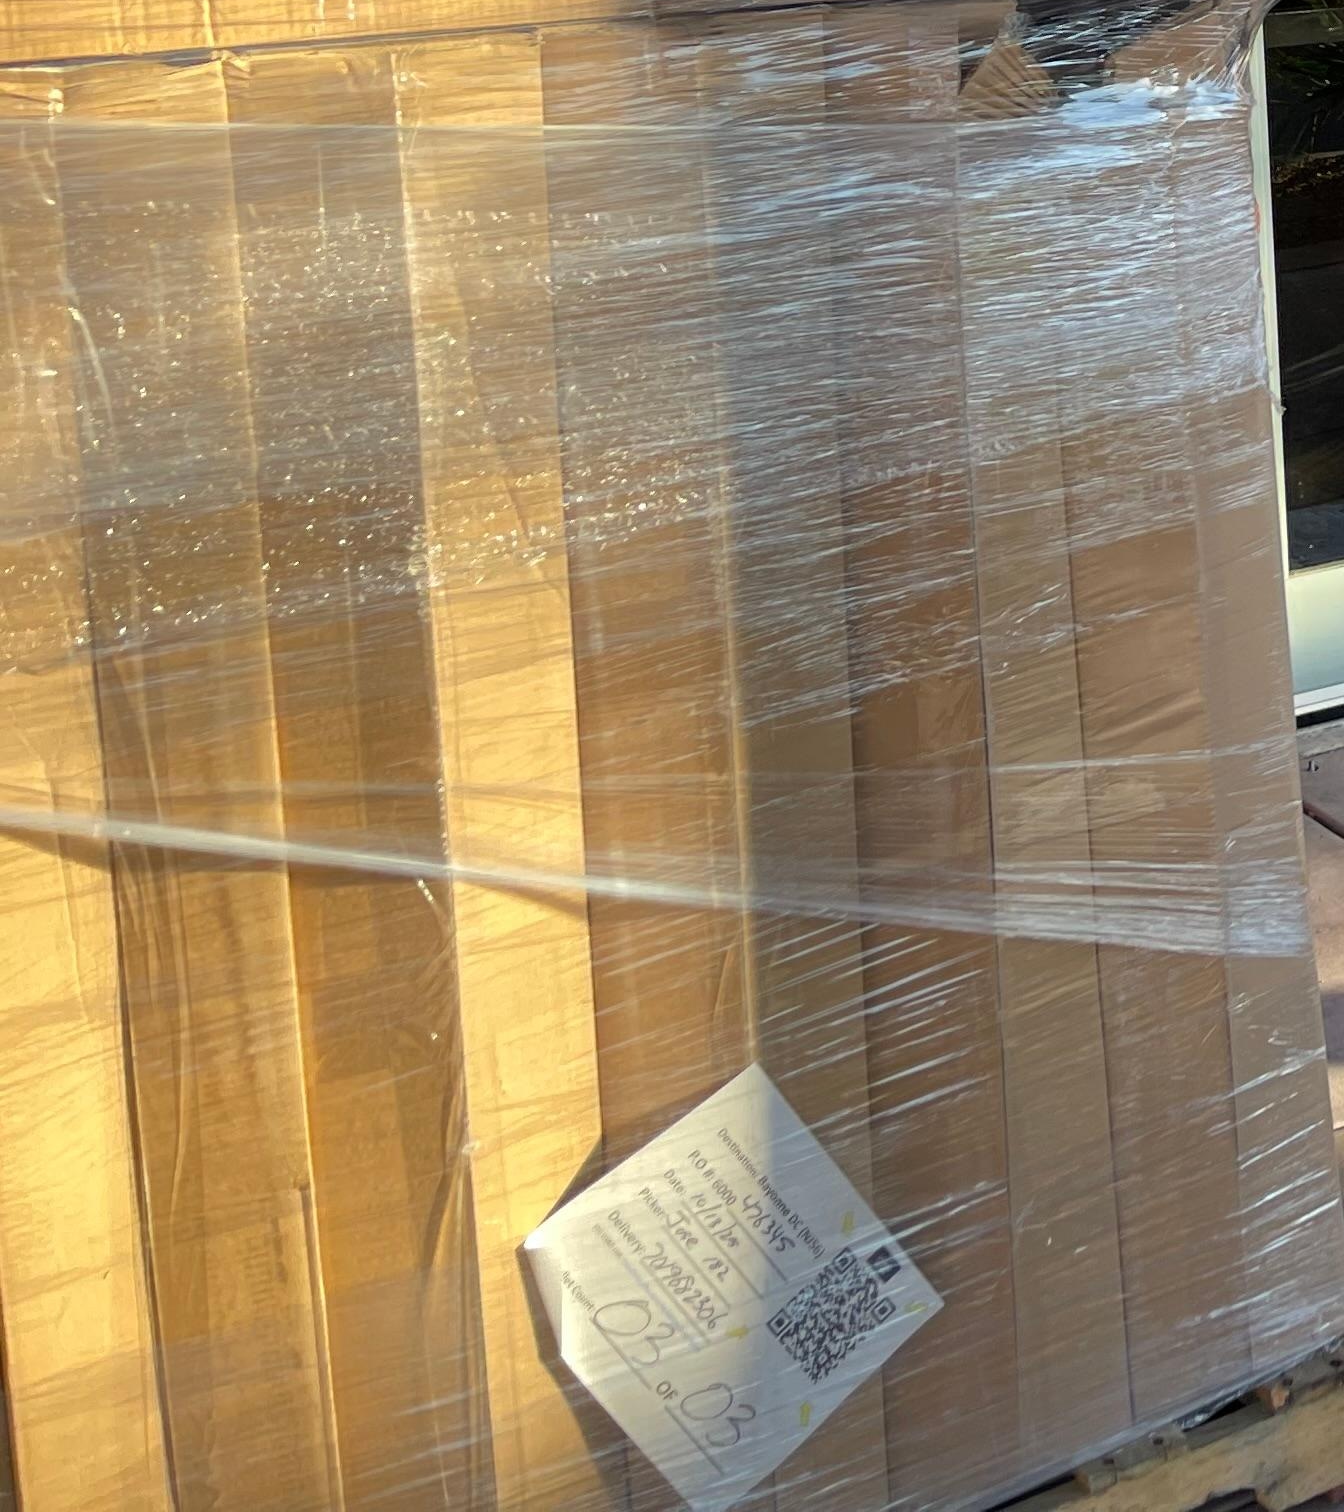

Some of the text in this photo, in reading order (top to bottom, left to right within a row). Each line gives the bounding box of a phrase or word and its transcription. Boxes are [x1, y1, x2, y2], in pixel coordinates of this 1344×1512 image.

[710, 1177, 738, 1208] 6000
[607, 1209, 648, 1257] Delivery:
[786, 1212, 804, 1231] DC
